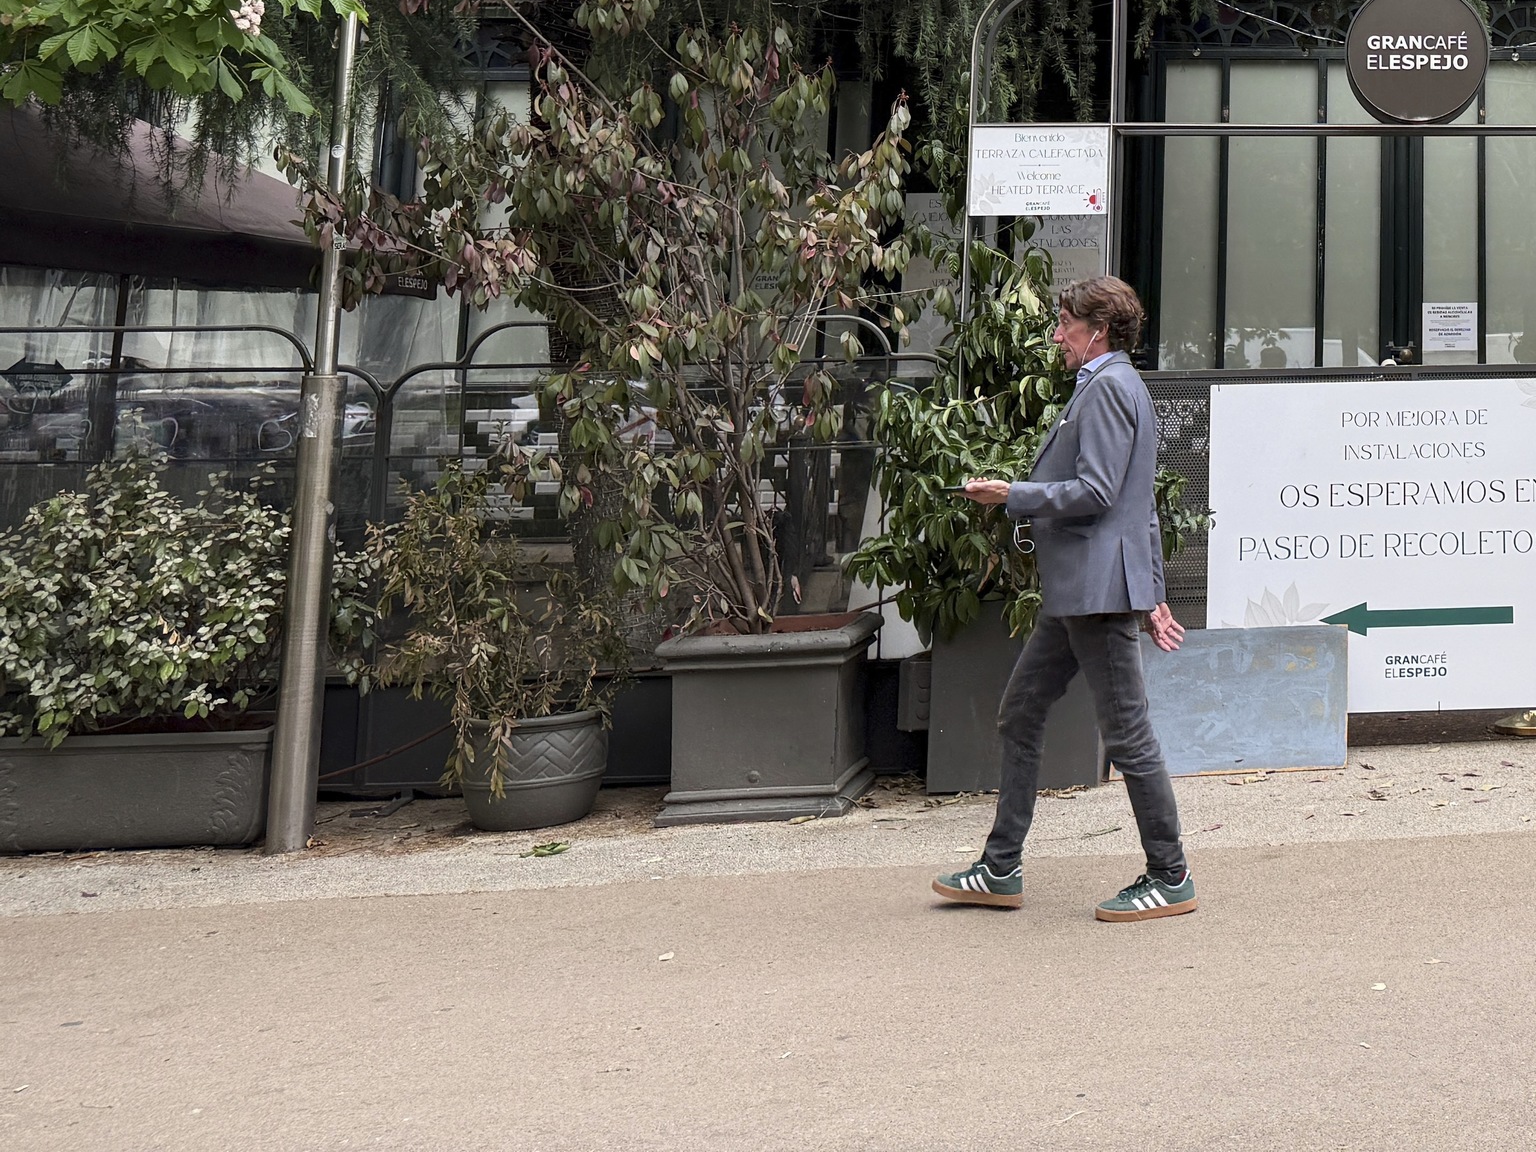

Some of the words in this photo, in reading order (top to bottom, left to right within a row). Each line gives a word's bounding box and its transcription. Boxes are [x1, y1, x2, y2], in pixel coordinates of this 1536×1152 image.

[1367, 31, 1468, 50] GRANCAFÉ
[1367, 54, 1469, 70] ELESPEJO
[1014, 133, 1065, 143] Bienvenido
[975, 149, 1026, 159] TERRAZA
[1029, 148, 1103, 159] CALEFACTADA
[1017, 171, 1061, 181] Welcome
[991, 185, 1033, 195] HEATED
[1036, 185, 1085, 195] TERRACE
[1341, 411, 1380, 428] POR
[1385, 410, 1460, 427] MEJORA
[1466, 409, 1488, 425] DE
[1344, 442, 1485, 461] INSTALACIONES
[1280, 484, 1319, 508] OS
[1330, 480, 1505, 507] ESPERAMOS
[1239, 535, 1329, 561] PASEO
[1340, 534, 1374, 559] DE
[1385, 651, 1447, 665] GRANCAFÉ
[1385, 667, 1447, 679] ELESPEJO
